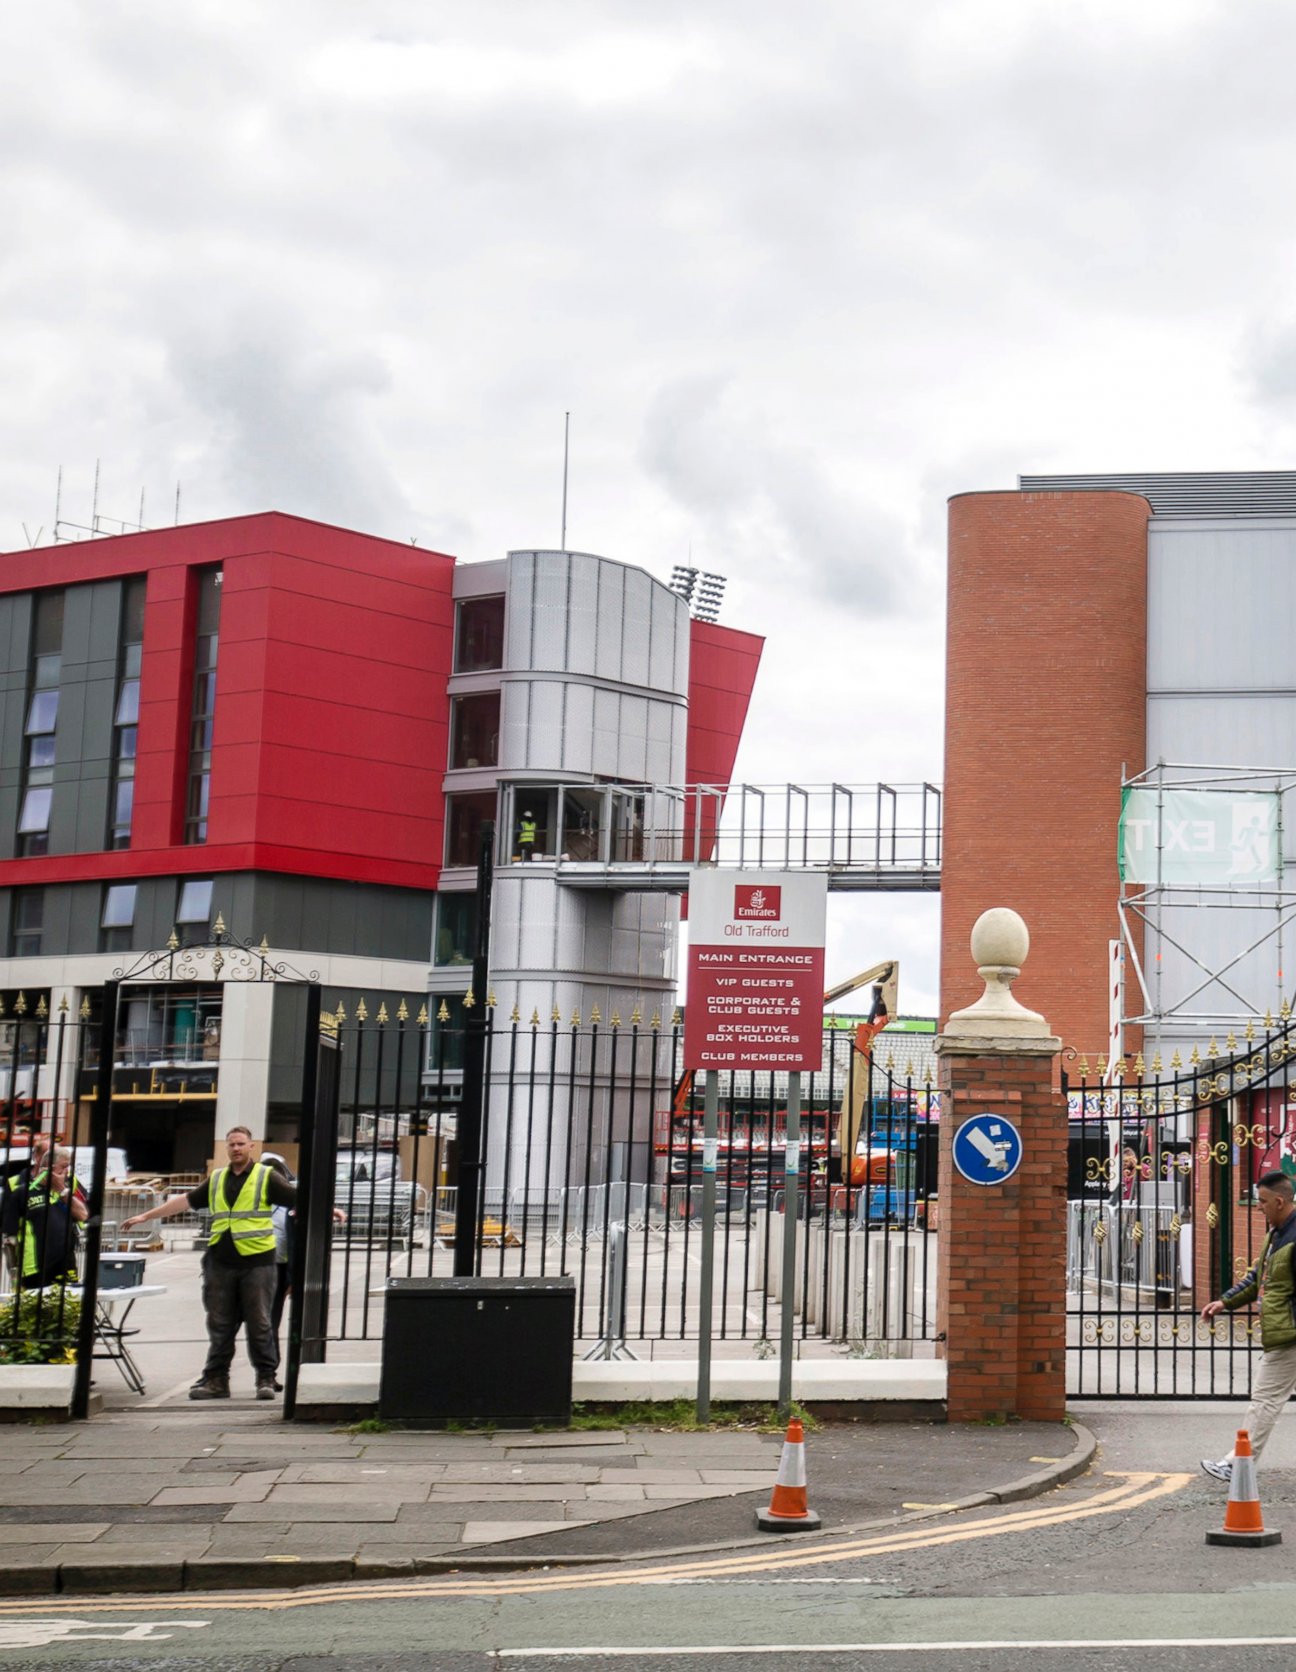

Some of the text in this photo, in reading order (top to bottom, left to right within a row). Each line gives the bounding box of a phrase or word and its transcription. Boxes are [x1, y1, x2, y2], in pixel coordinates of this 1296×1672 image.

[738, 907, 777, 917] Emirates
[724, 924, 790, 938] Old Trafford
[698, 953, 813, 964] MAIN ENTRANCE
[716, 978, 794, 988] VIP GUESTS
[707, 996, 801, 1006] CORPORATE &
[708, 1006, 800, 1016] CLUB GUESTS
[718, 1024, 789, 1034] EXECUTIVE
[706, 1034, 800, 1043] BOX HOLDERS
[701, 1052, 803, 1062] CLUB MEMBERS
